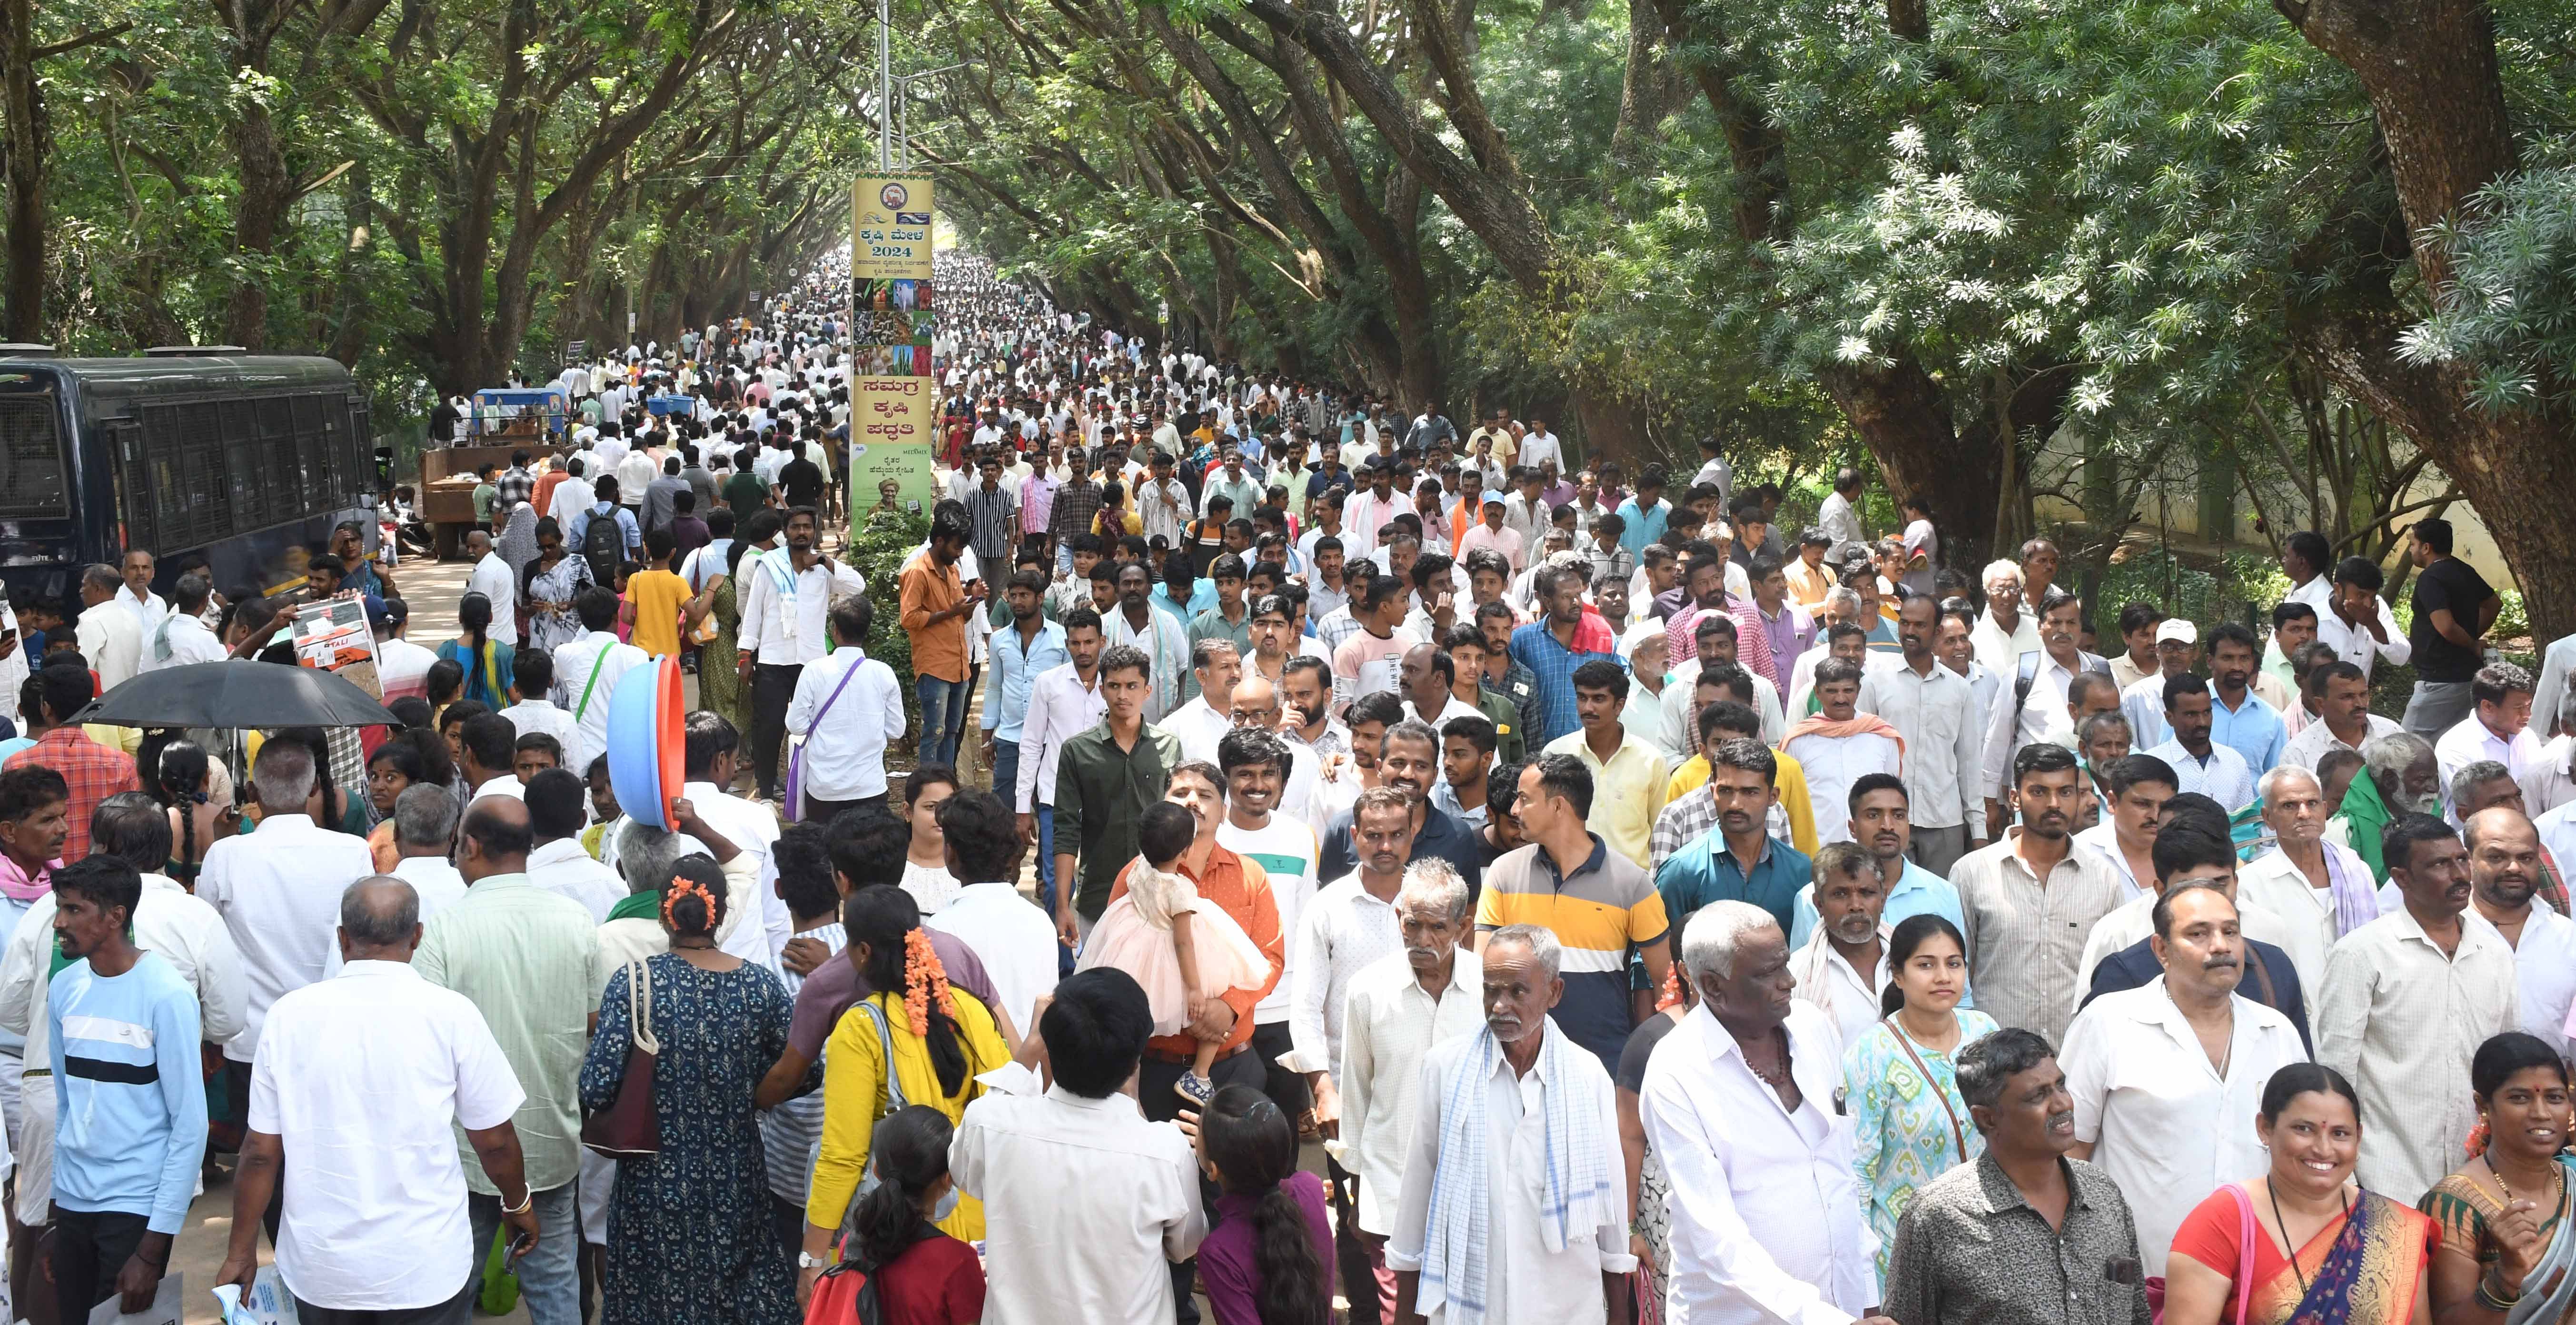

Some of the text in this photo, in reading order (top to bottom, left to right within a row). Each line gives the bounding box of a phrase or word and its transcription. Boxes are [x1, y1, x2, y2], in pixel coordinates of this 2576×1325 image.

[861, 228, 923, 244] ಕೃಷಿ ಮೇಳ
[872, 246, 912, 257] 2024
[863, 379, 919, 396] ಸಮಗ್ರ
[873, 400, 908, 418] ಕೃಷಿ
[867, 422, 914, 441] ಪದ್ಧತಿ
[884, 457, 900, 466] ರೈತರ
[869, 466, 894, 476] ಹೆಮ್ಮೆಯ
